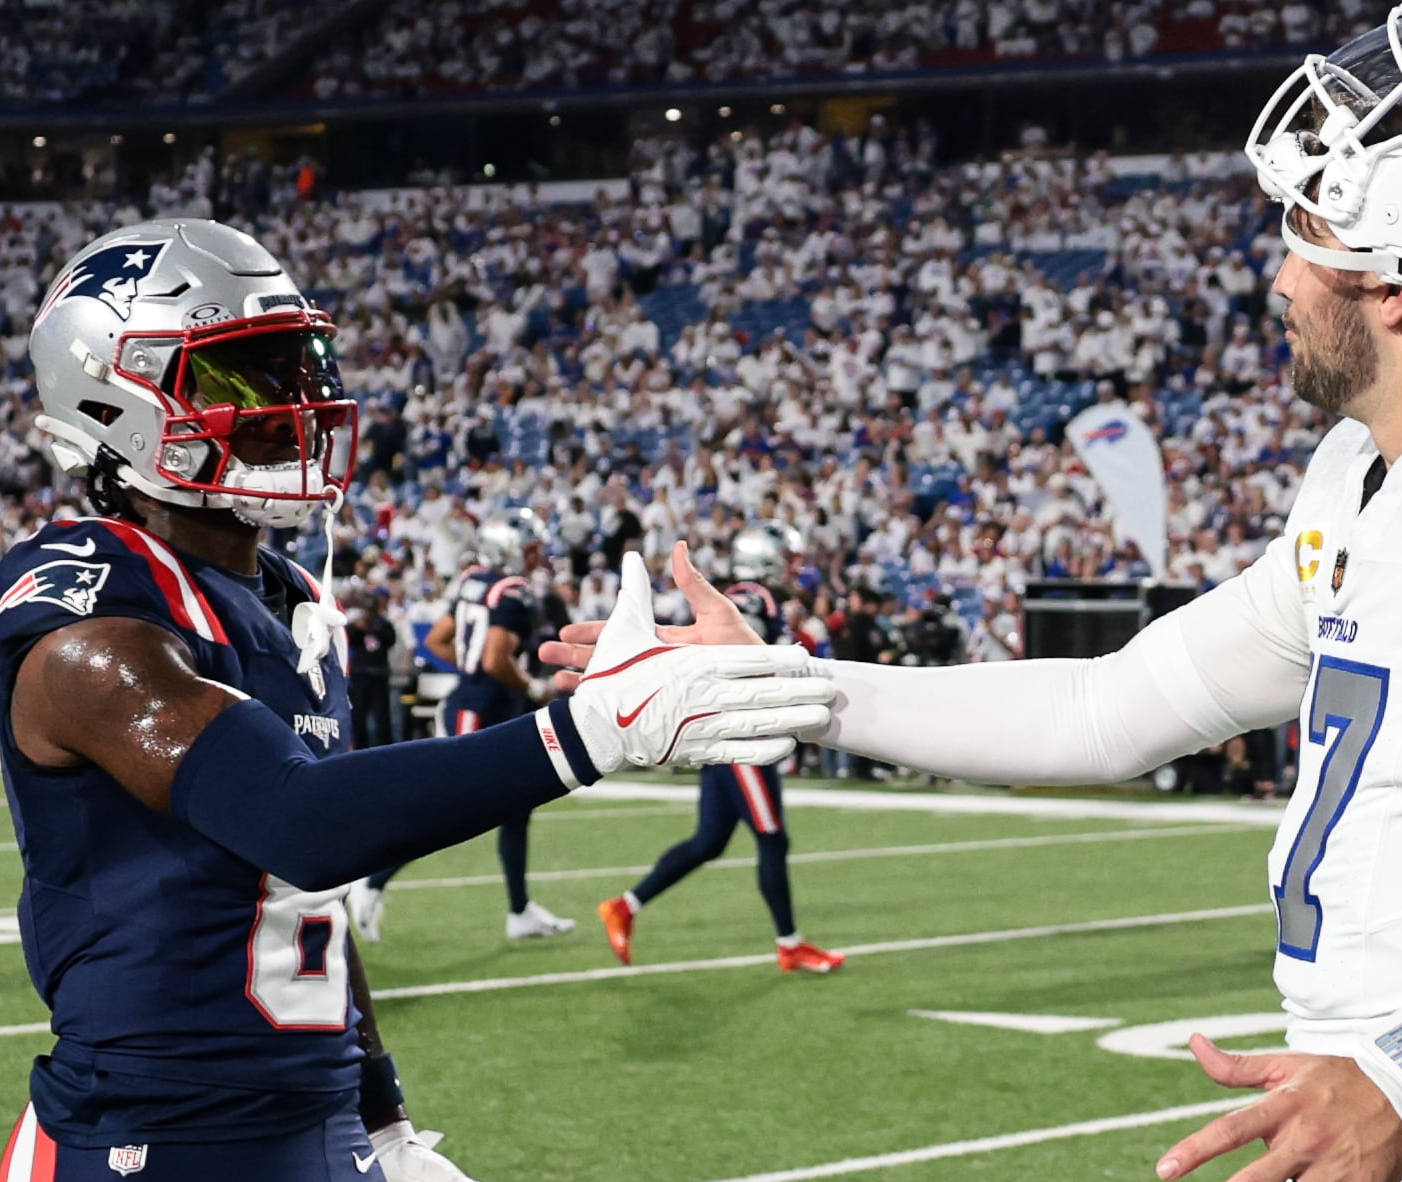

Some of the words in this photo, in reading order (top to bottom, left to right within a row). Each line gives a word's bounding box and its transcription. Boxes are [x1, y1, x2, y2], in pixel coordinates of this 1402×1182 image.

[1294, 529, 1324, 582] C
[541, 727, 561, 752] NIKE
[115, 1150, 139, 1167] NFL
